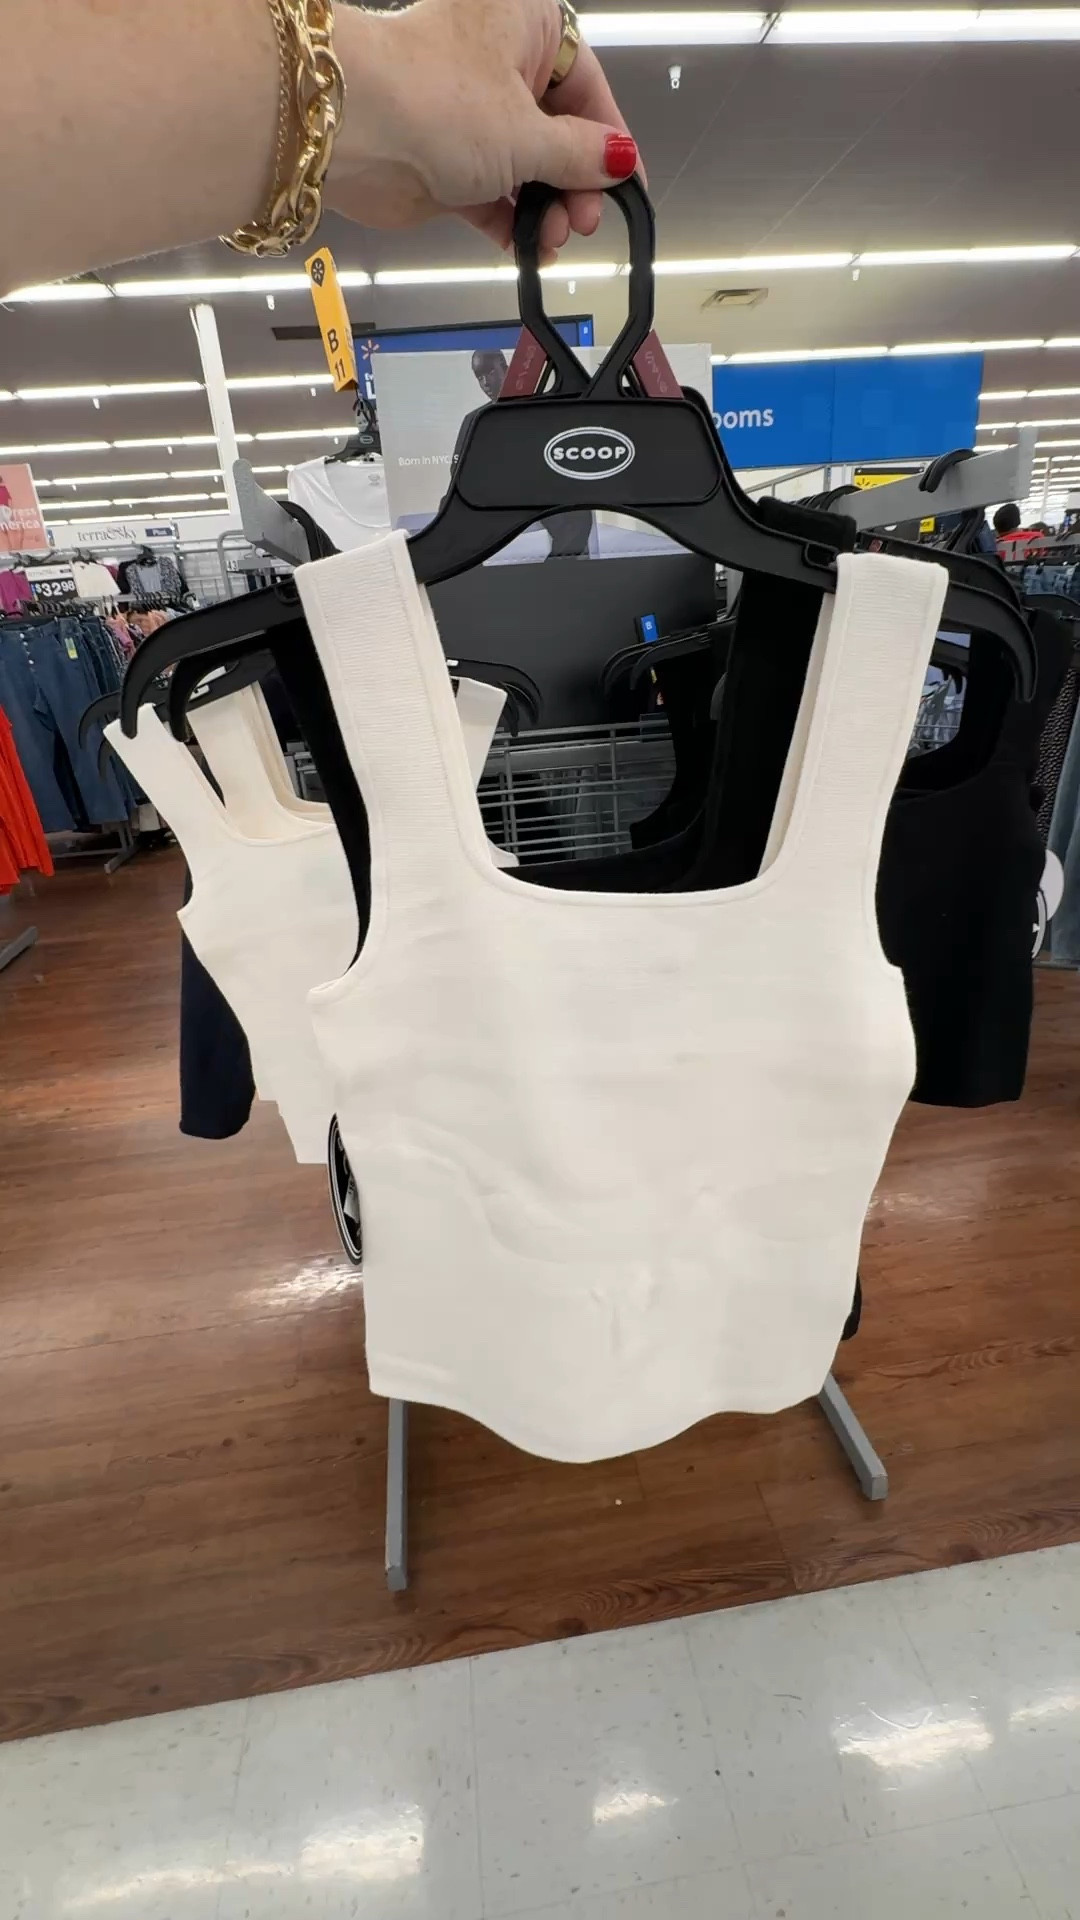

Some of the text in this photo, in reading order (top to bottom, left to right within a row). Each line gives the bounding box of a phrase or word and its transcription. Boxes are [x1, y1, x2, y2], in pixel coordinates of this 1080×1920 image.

[327, 328, 339, 354] B
[334, 358, 346, 382] 11
[712, 408, 774, 429] ooms
[552, 446, 627, 460] SCOOP
[0, 519, 41, 531] merica
[645, 621, 653, 630] B
